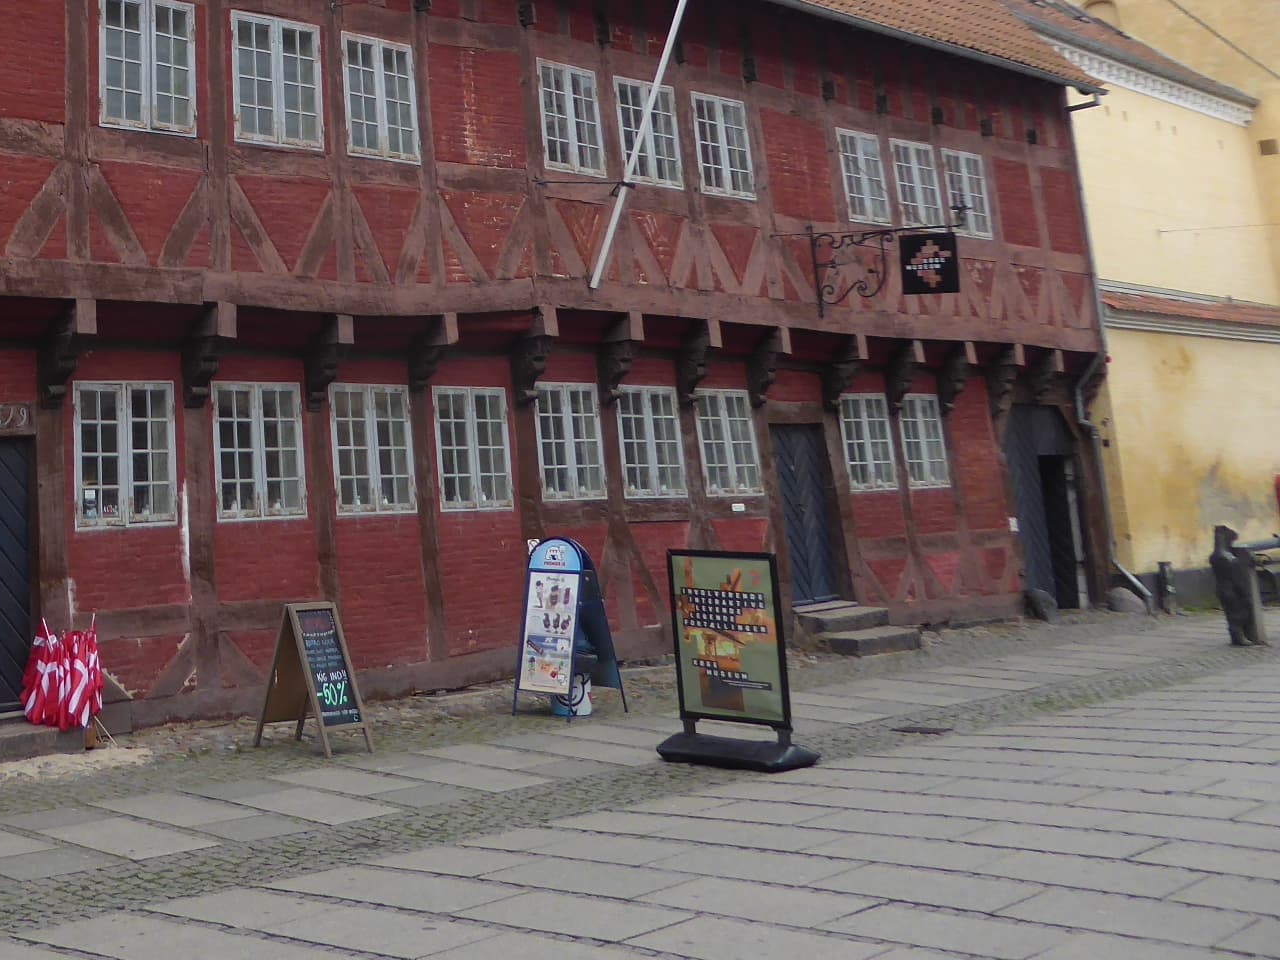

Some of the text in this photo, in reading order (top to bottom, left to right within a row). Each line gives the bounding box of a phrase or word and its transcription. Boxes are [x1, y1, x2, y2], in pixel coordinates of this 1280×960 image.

[681, 588, 764, 600] INVOLVERENDE
[688, 596, 764, 609] INTERAKTIVE
[695, 604, 741, 615] LEVENDE
[706, 669, 748, 680] MUSEUM
